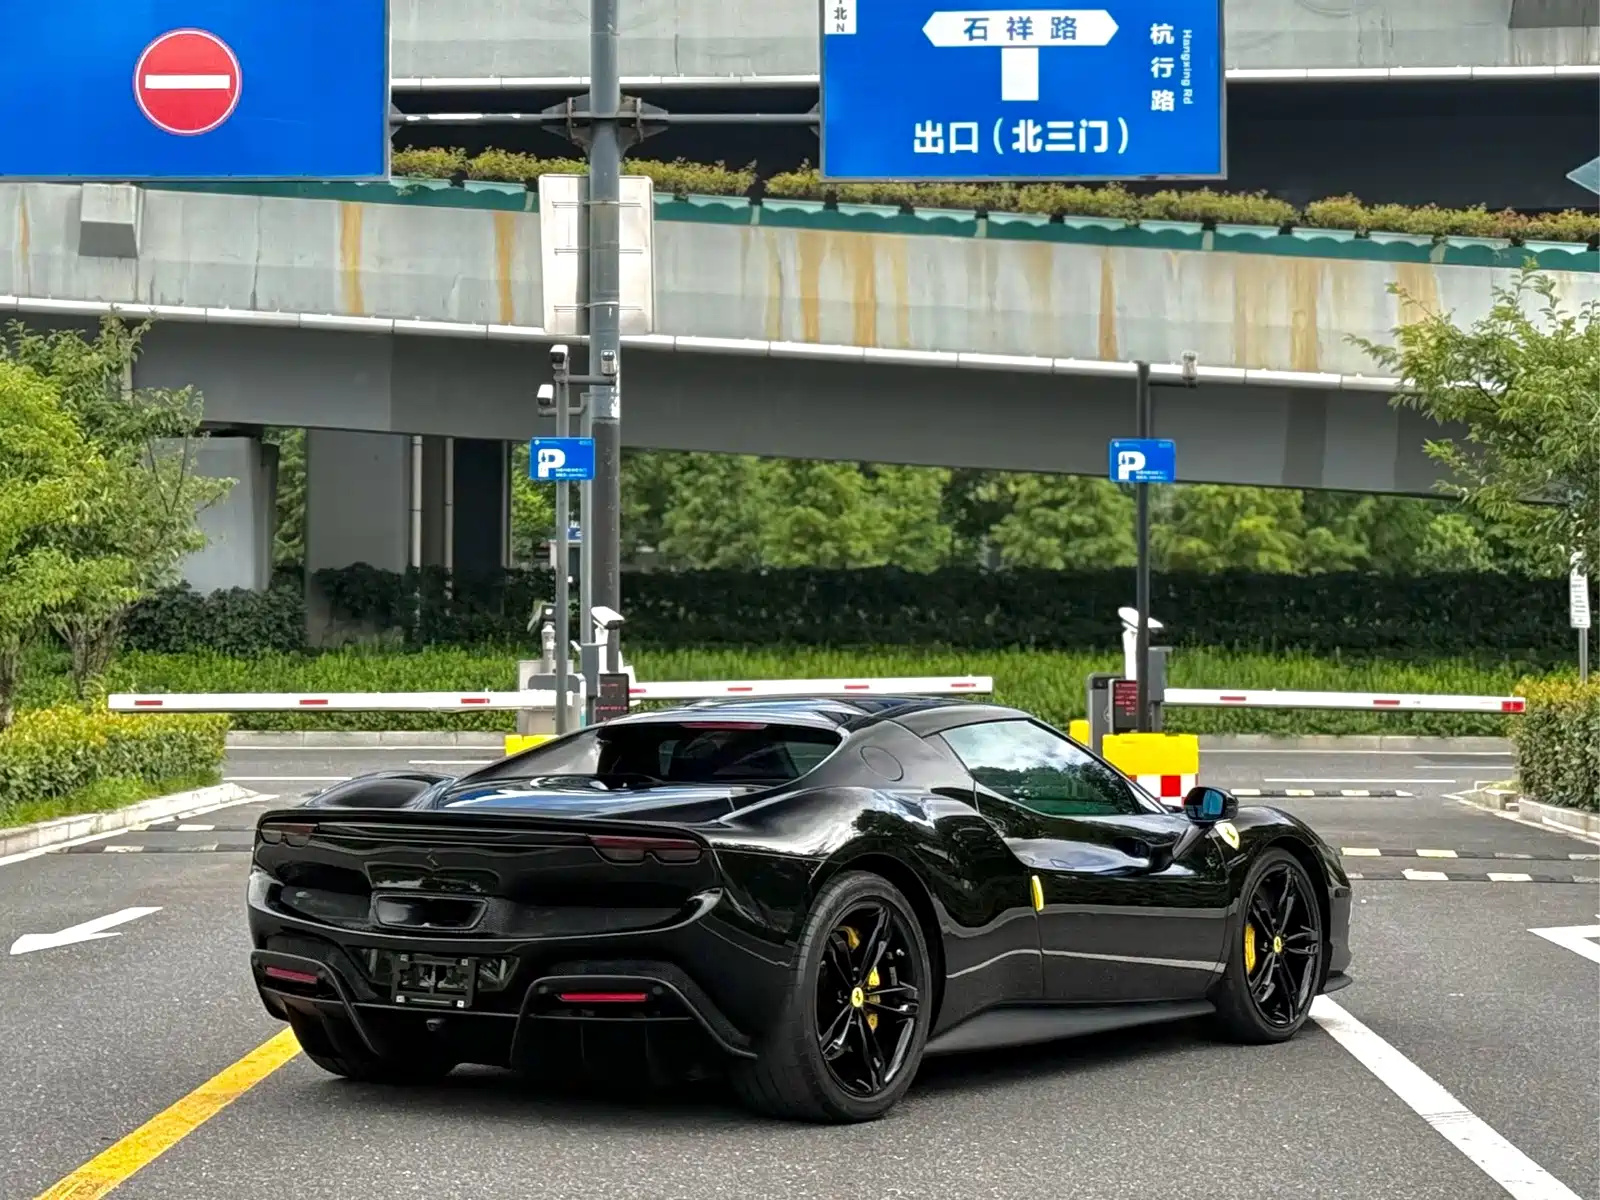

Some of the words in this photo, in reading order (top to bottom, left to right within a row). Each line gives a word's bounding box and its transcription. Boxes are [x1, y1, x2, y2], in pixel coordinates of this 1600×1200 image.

[833, 6, 848, 20] 北
[836, 23, 845, 32] N
[963, 16, 1077, 41] 石祥路
[1150, 23, 1175, 112] 杭行路
[1181, 29, 1193, 87] Hangxing
[1183, 89, 1194, 105] Rd
[538, 448, 566, 478] P
[1118, 451, 1146, 480] P
